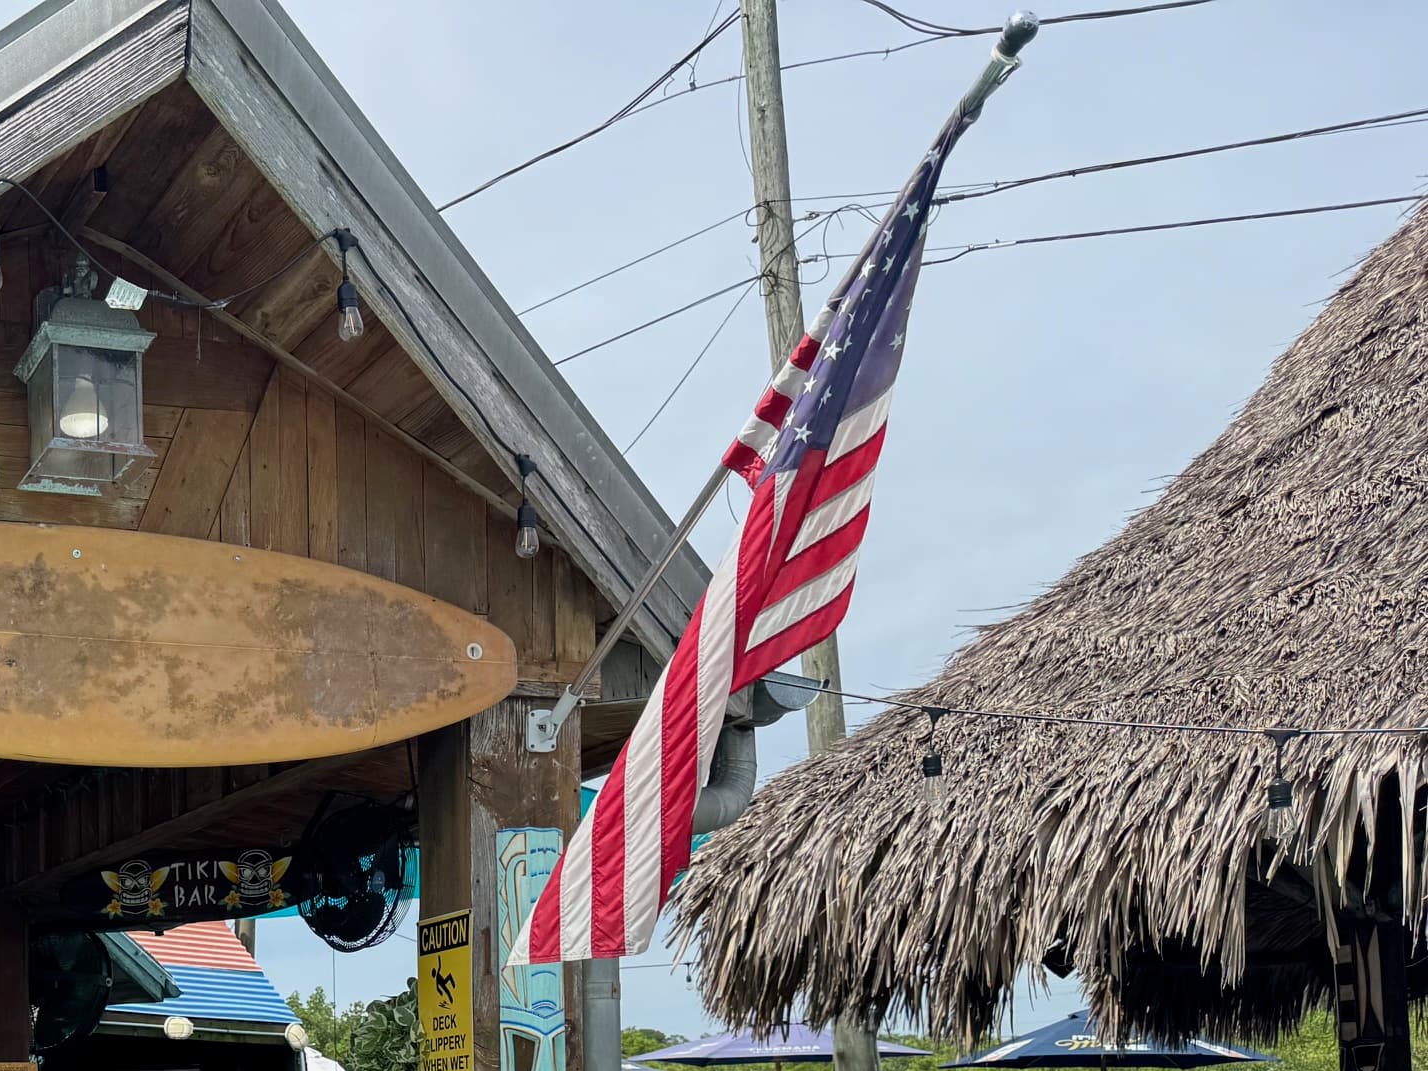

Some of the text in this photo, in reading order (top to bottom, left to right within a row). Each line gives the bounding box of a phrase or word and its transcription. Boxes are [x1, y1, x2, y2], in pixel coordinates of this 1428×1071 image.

[170, 860, 217, 882] TIKI
[174, 884, 217, 908] BAR
[422, 917, 467, 952] CAUTION
[433, 1013, 457, 1032] DECK
[450, 1055, 470, 1071] WET
